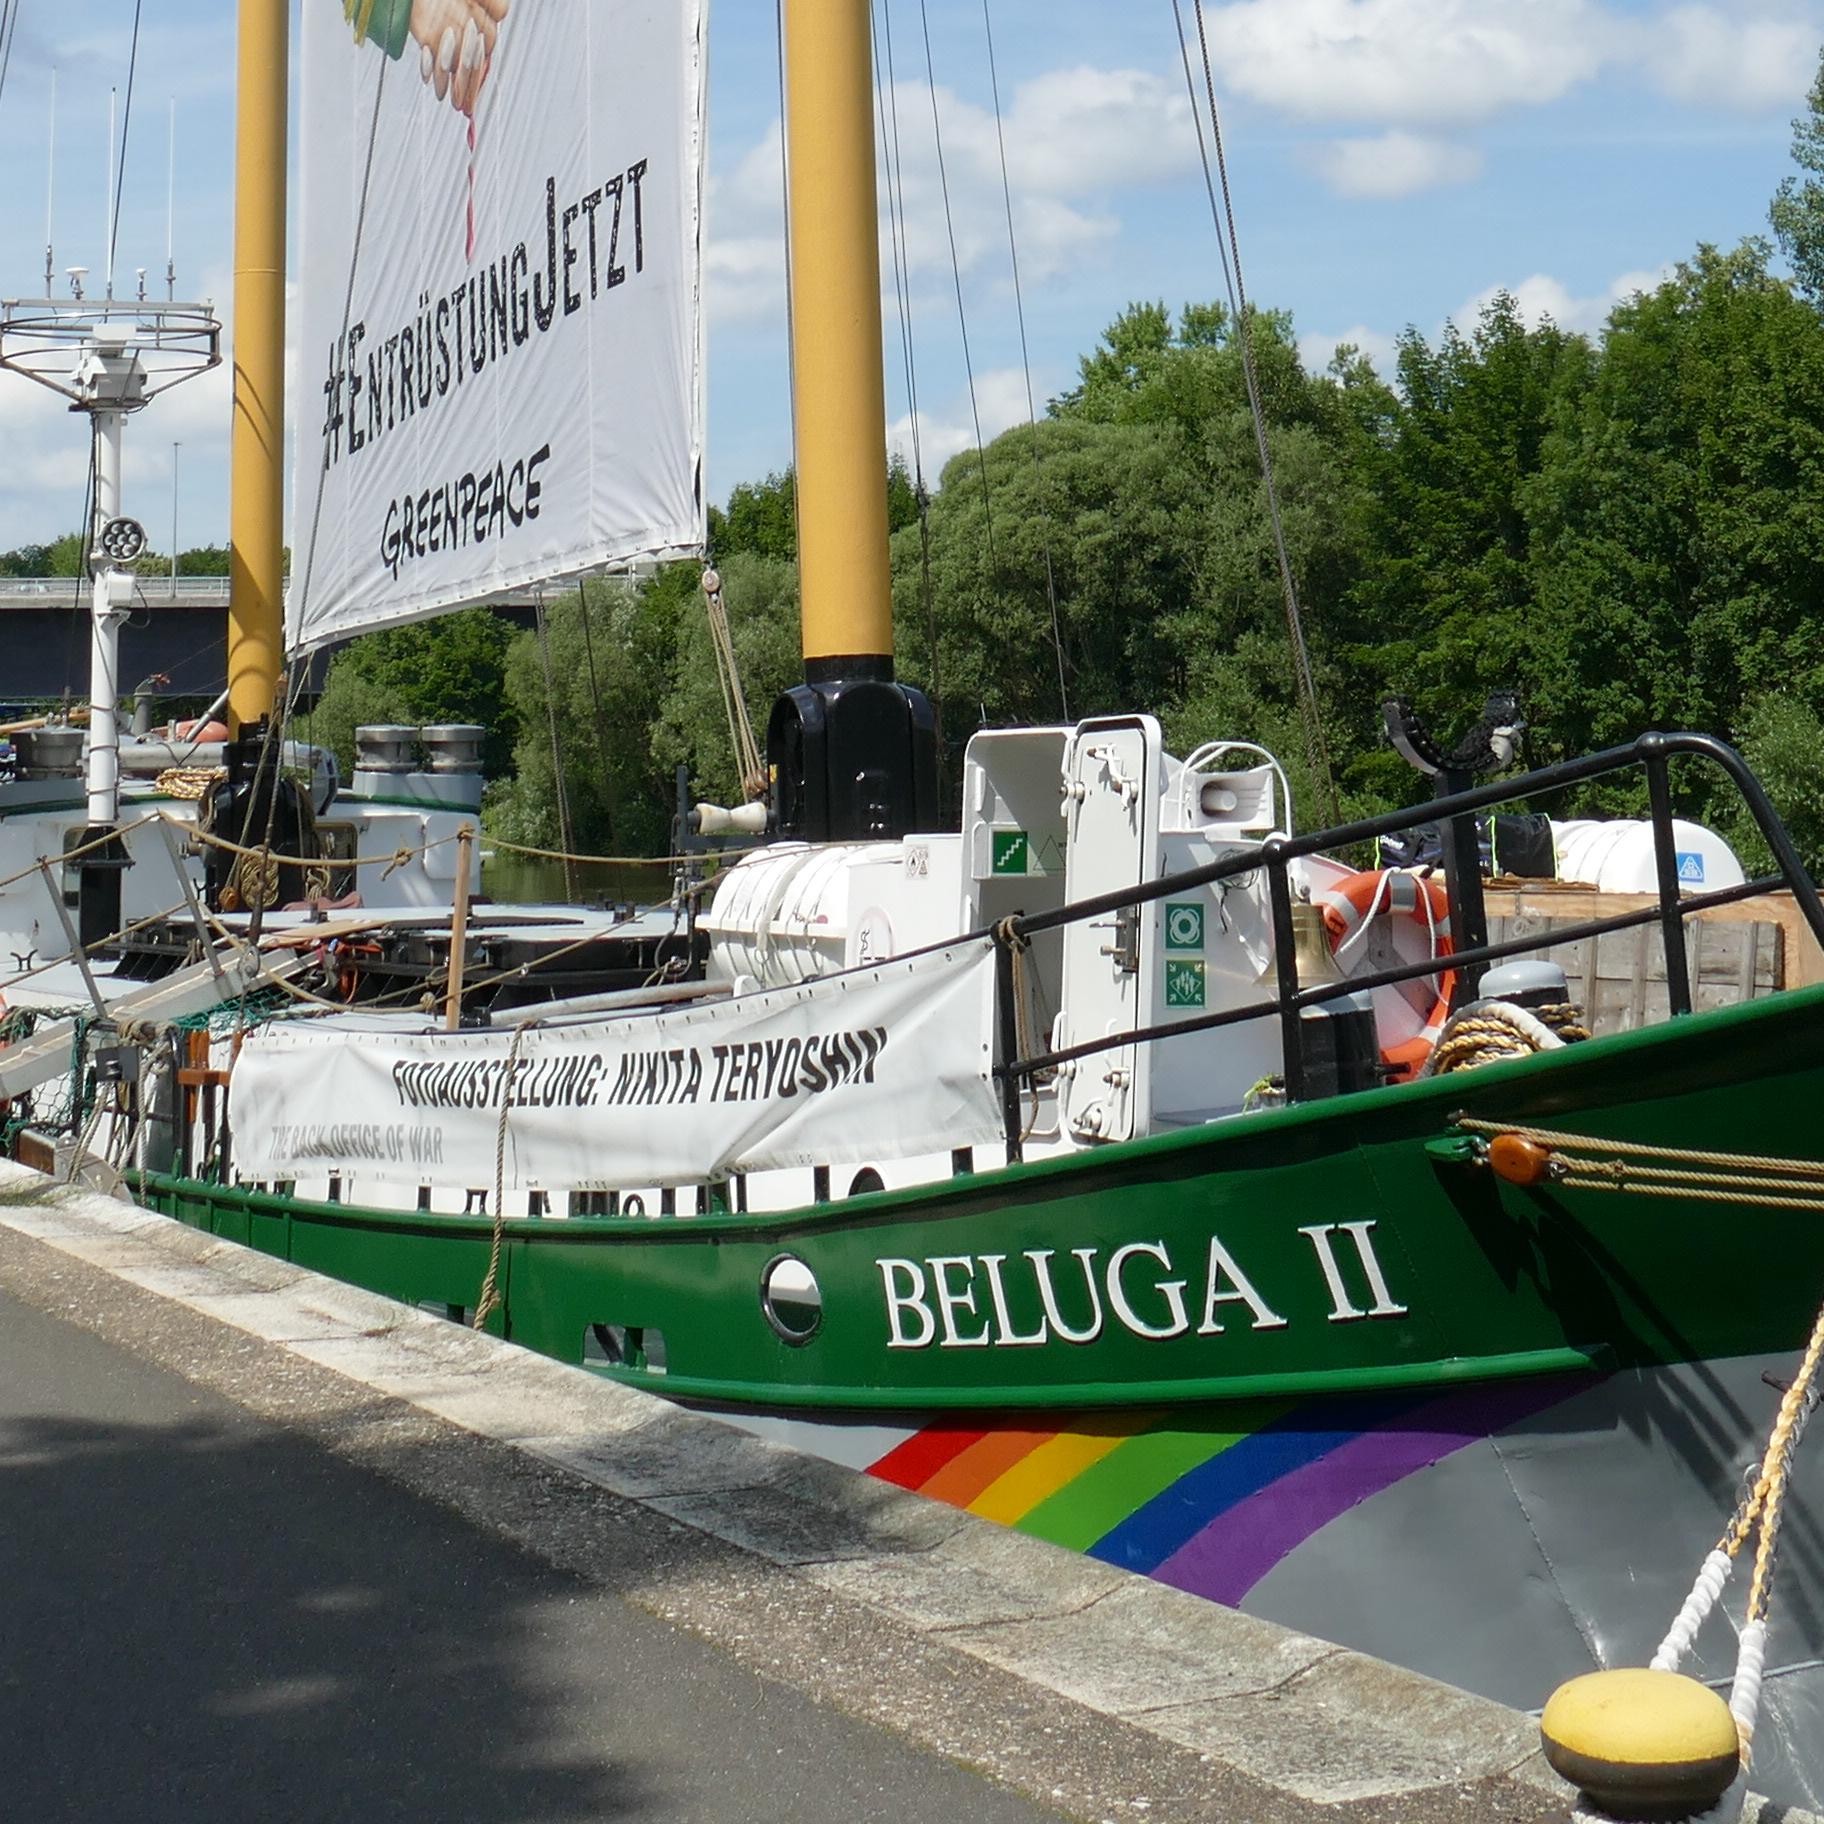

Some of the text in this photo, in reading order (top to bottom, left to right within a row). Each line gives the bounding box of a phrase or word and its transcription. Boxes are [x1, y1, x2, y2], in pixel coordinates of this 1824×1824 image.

[380, 444, 550, 581] GREENPEACE
[392, 1026, 888, 1109] FOTOAUSSTELLUNG: NIKITA TERYOSHIN
[269, 1124, 443, 1164] THE BACK OFFICE OF WAR
[875, 1220, 1408, 1349] BELUGA II
